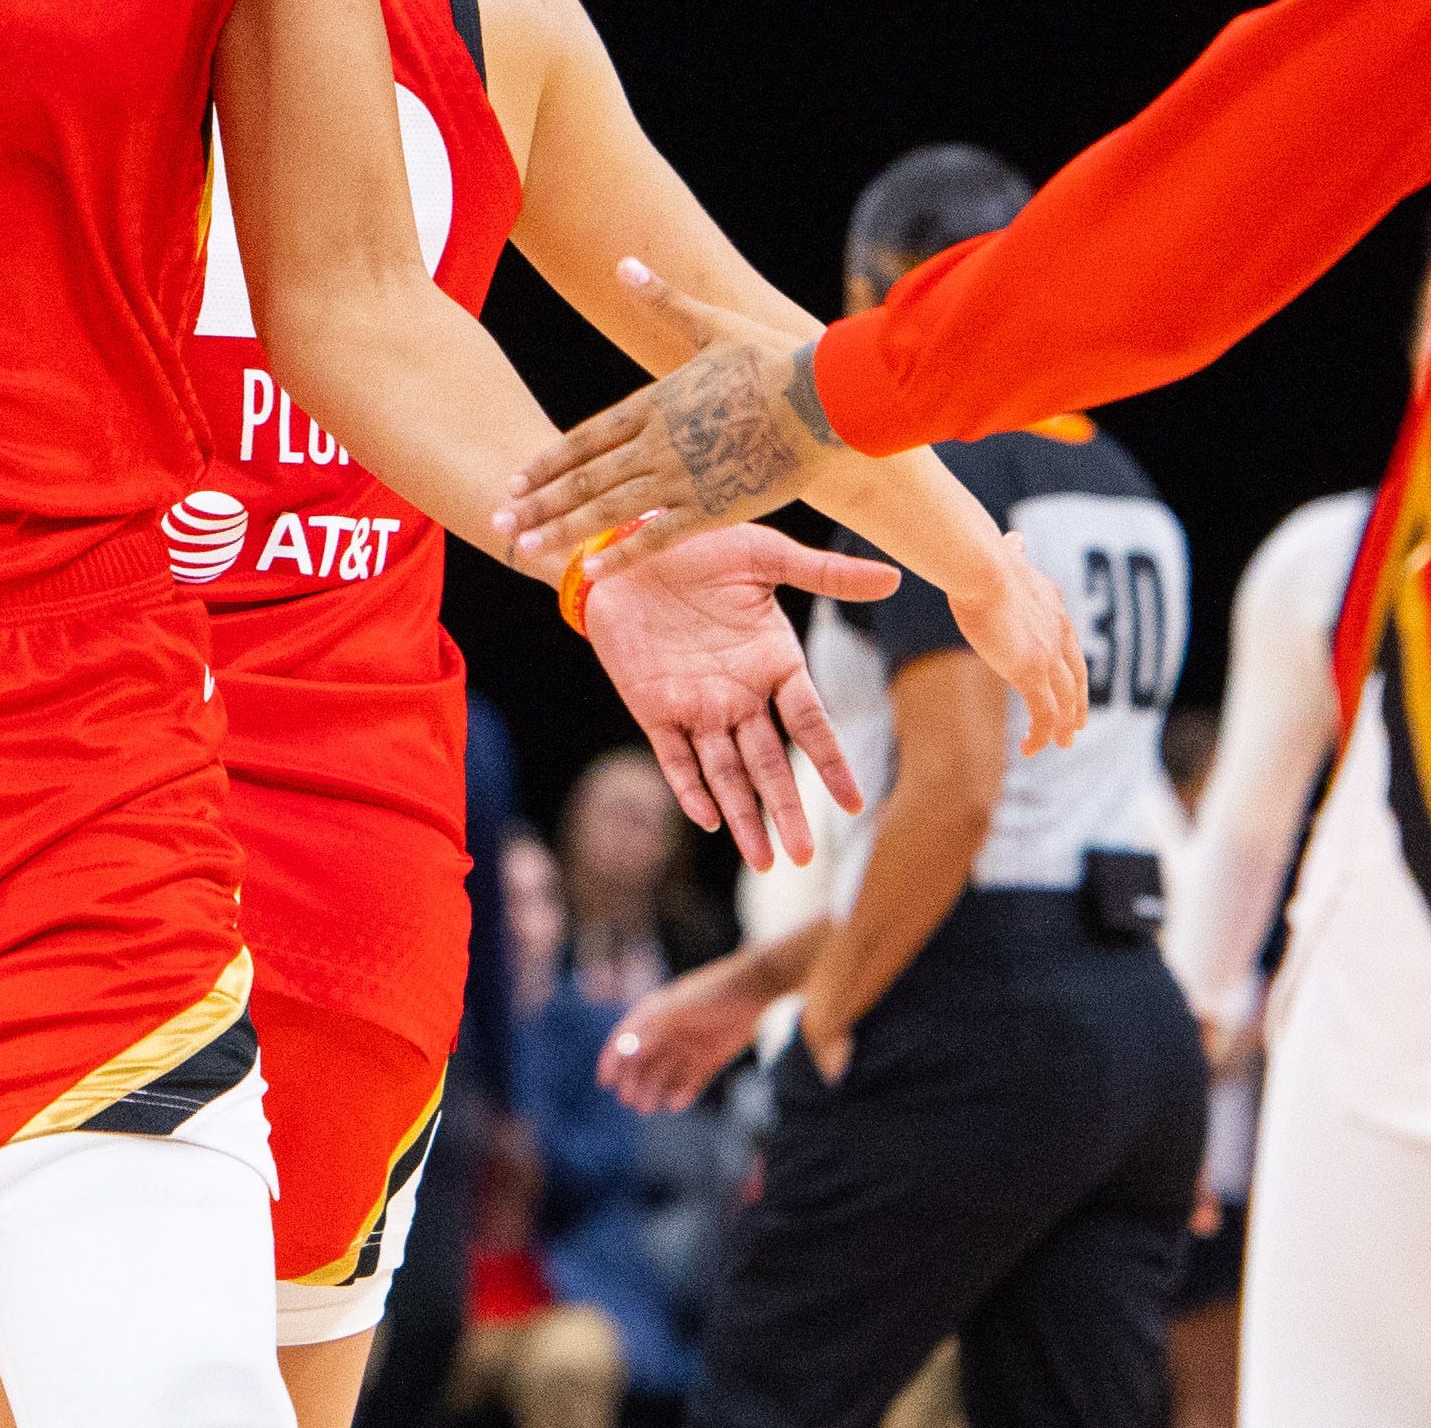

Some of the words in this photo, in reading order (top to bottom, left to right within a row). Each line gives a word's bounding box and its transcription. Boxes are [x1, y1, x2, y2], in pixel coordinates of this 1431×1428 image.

[240, 368, 350, 466] PLU
[255, 511, 401, 580] AT&T
[1084, 546, 1167, 710] 30
